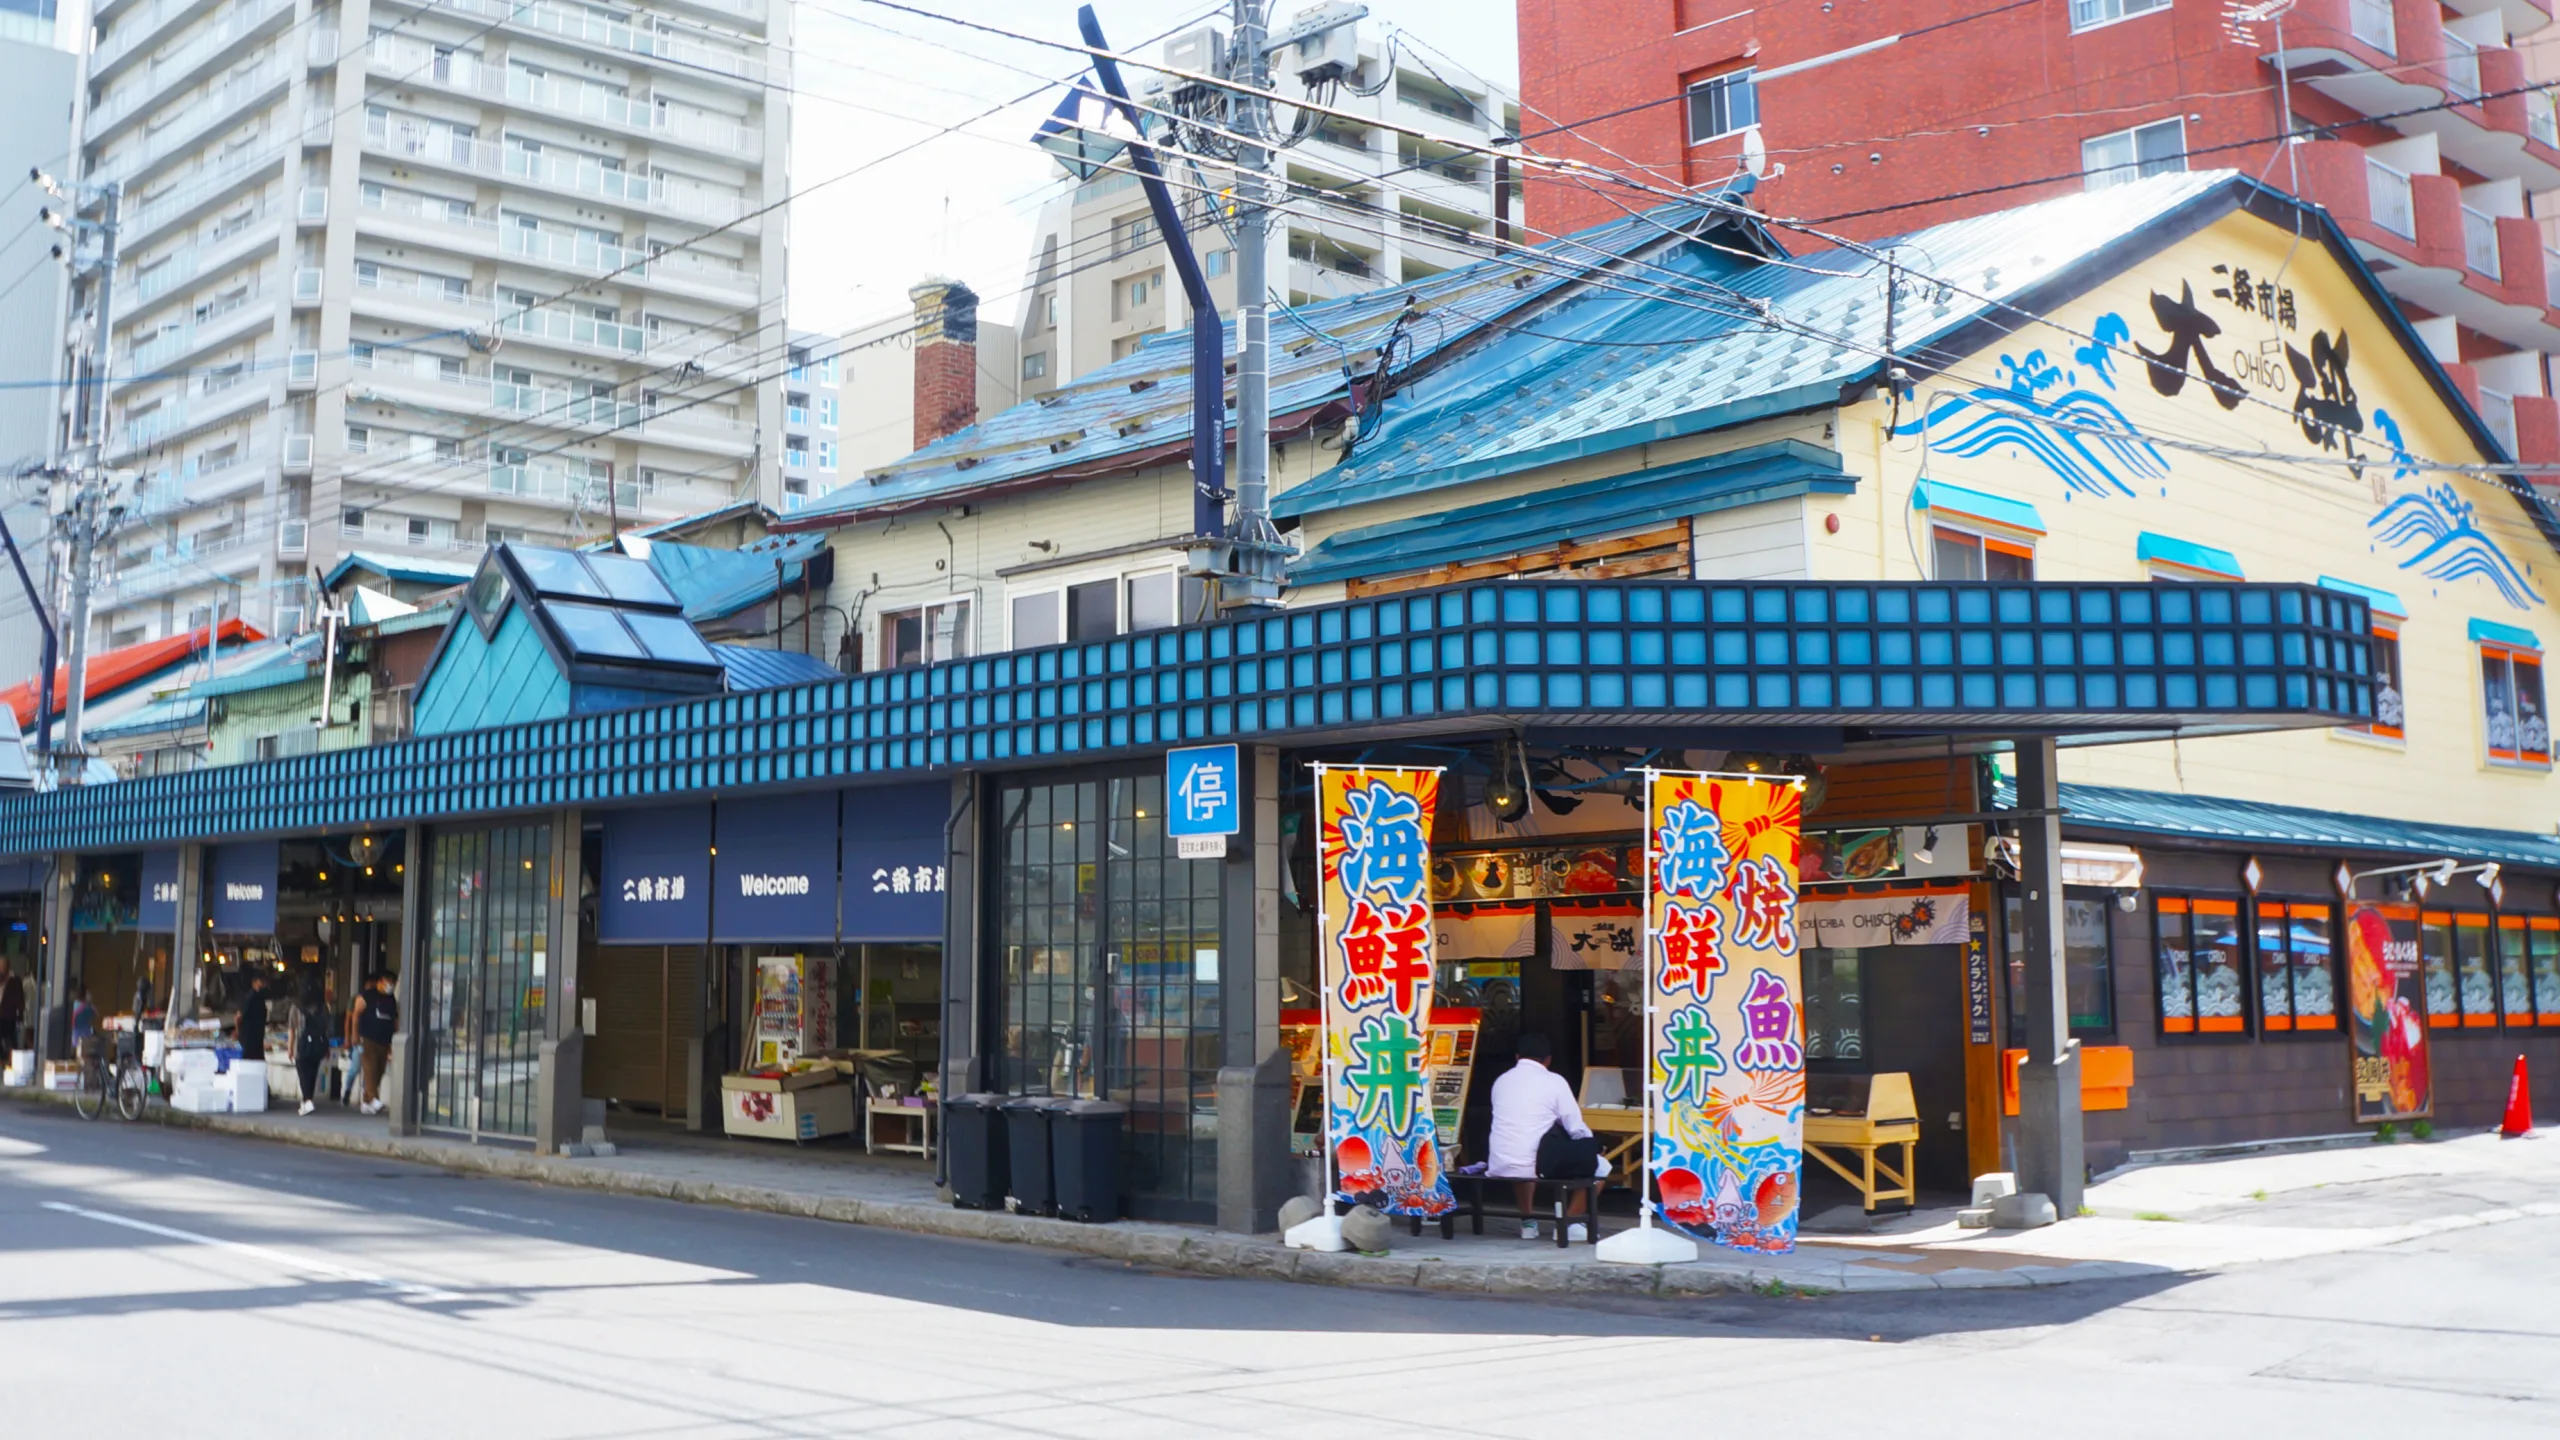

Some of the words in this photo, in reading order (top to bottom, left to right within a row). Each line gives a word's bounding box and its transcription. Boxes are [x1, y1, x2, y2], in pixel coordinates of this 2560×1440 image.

[2211, 264, 2298, 332] 二条市場
[2233, 349, 2286, 392] OHISO
[1178, 761, 1228, 821] 停
[226, 882, 263, 900] Welcome
[623, 875, 685, 902] 二条市場
[740, 873, 809, 897] Welcome
[1338, 779, 1431, 1138] 海鮮丼
[1657, 797, 1731, 1106] 海鮮丼
[1732, 855, 1804, 1073] 焼魚
[1970, 954, 1984, 1017] クラシック
